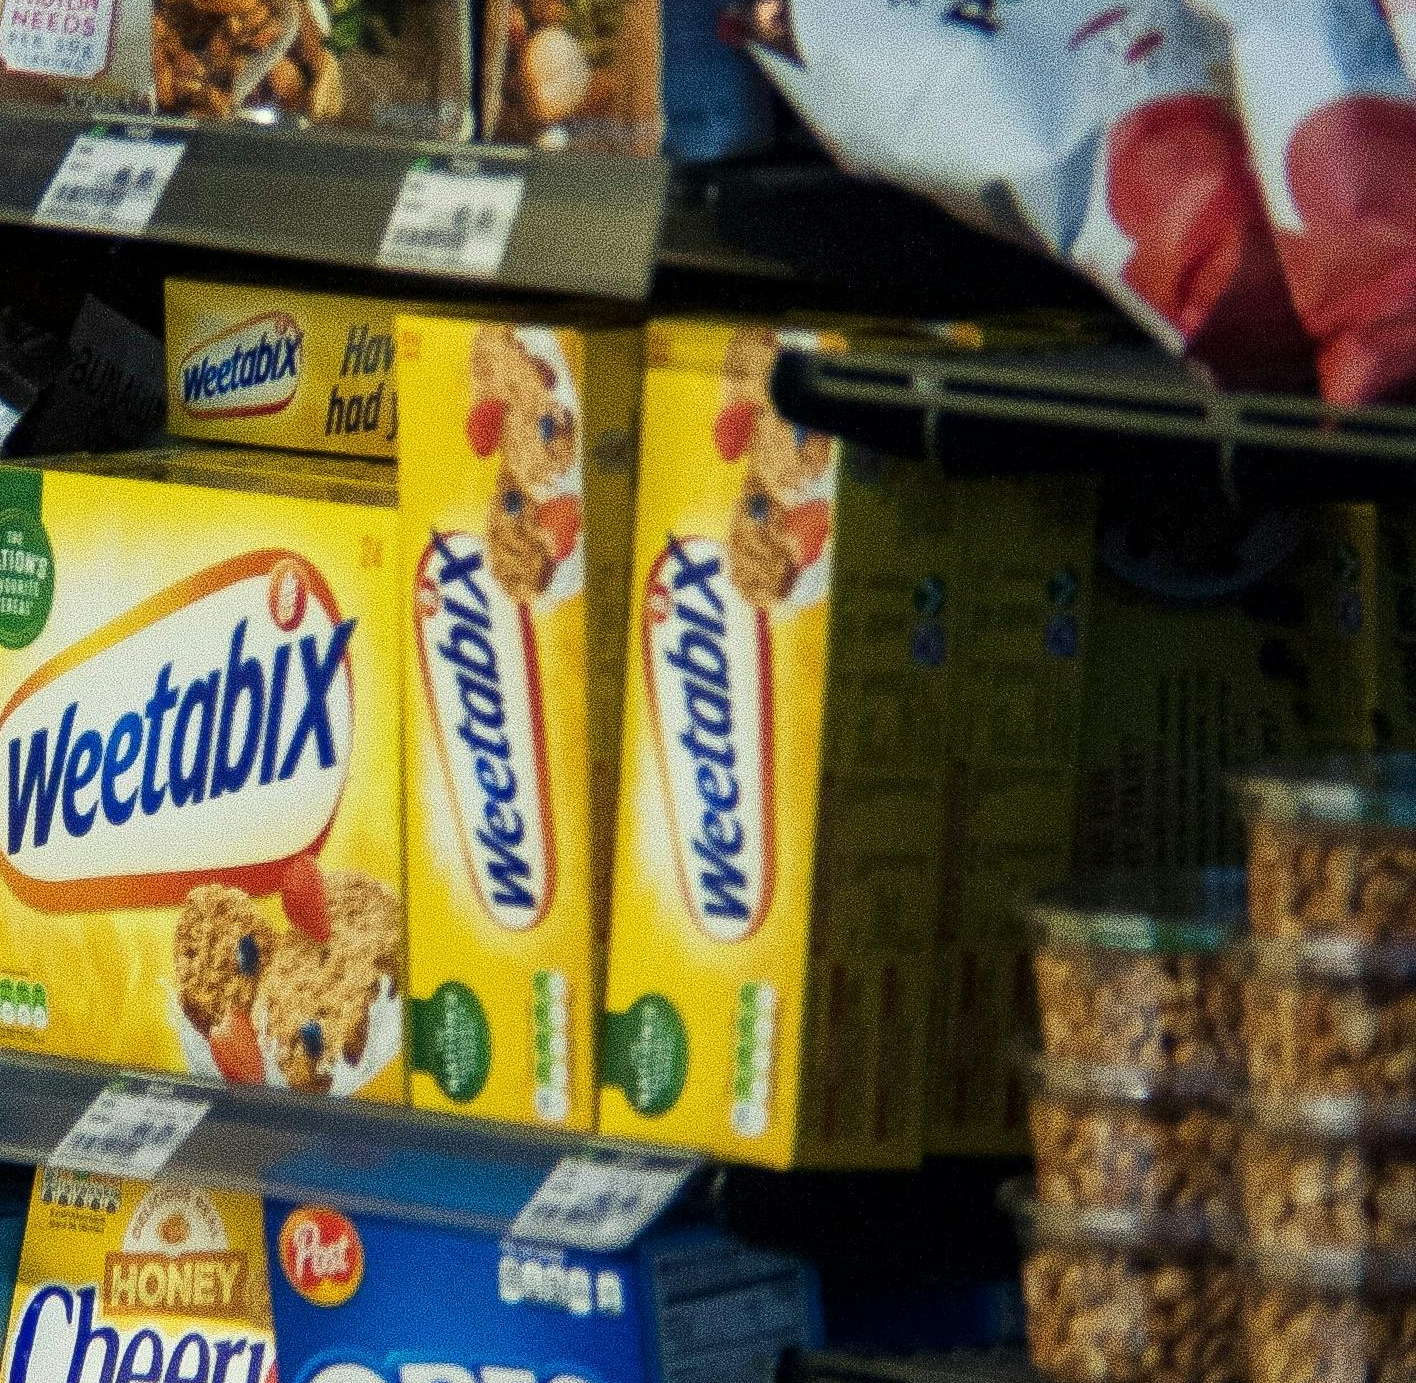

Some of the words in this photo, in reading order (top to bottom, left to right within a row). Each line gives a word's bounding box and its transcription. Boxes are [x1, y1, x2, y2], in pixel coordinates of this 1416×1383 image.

[11, 9, 96, 38] NEEDS
[182, 329, 305, 404] Weetabix
[324, 381, 383, 438] had
[5, 616, 357, 857] Weetabix
[431, 524, 538, 911] Weetabix
[664, 530, 750, 923] Weetabix
[291, 1224, 353, 1279] Post
[110, 1261, 240, 1309] HONEY
